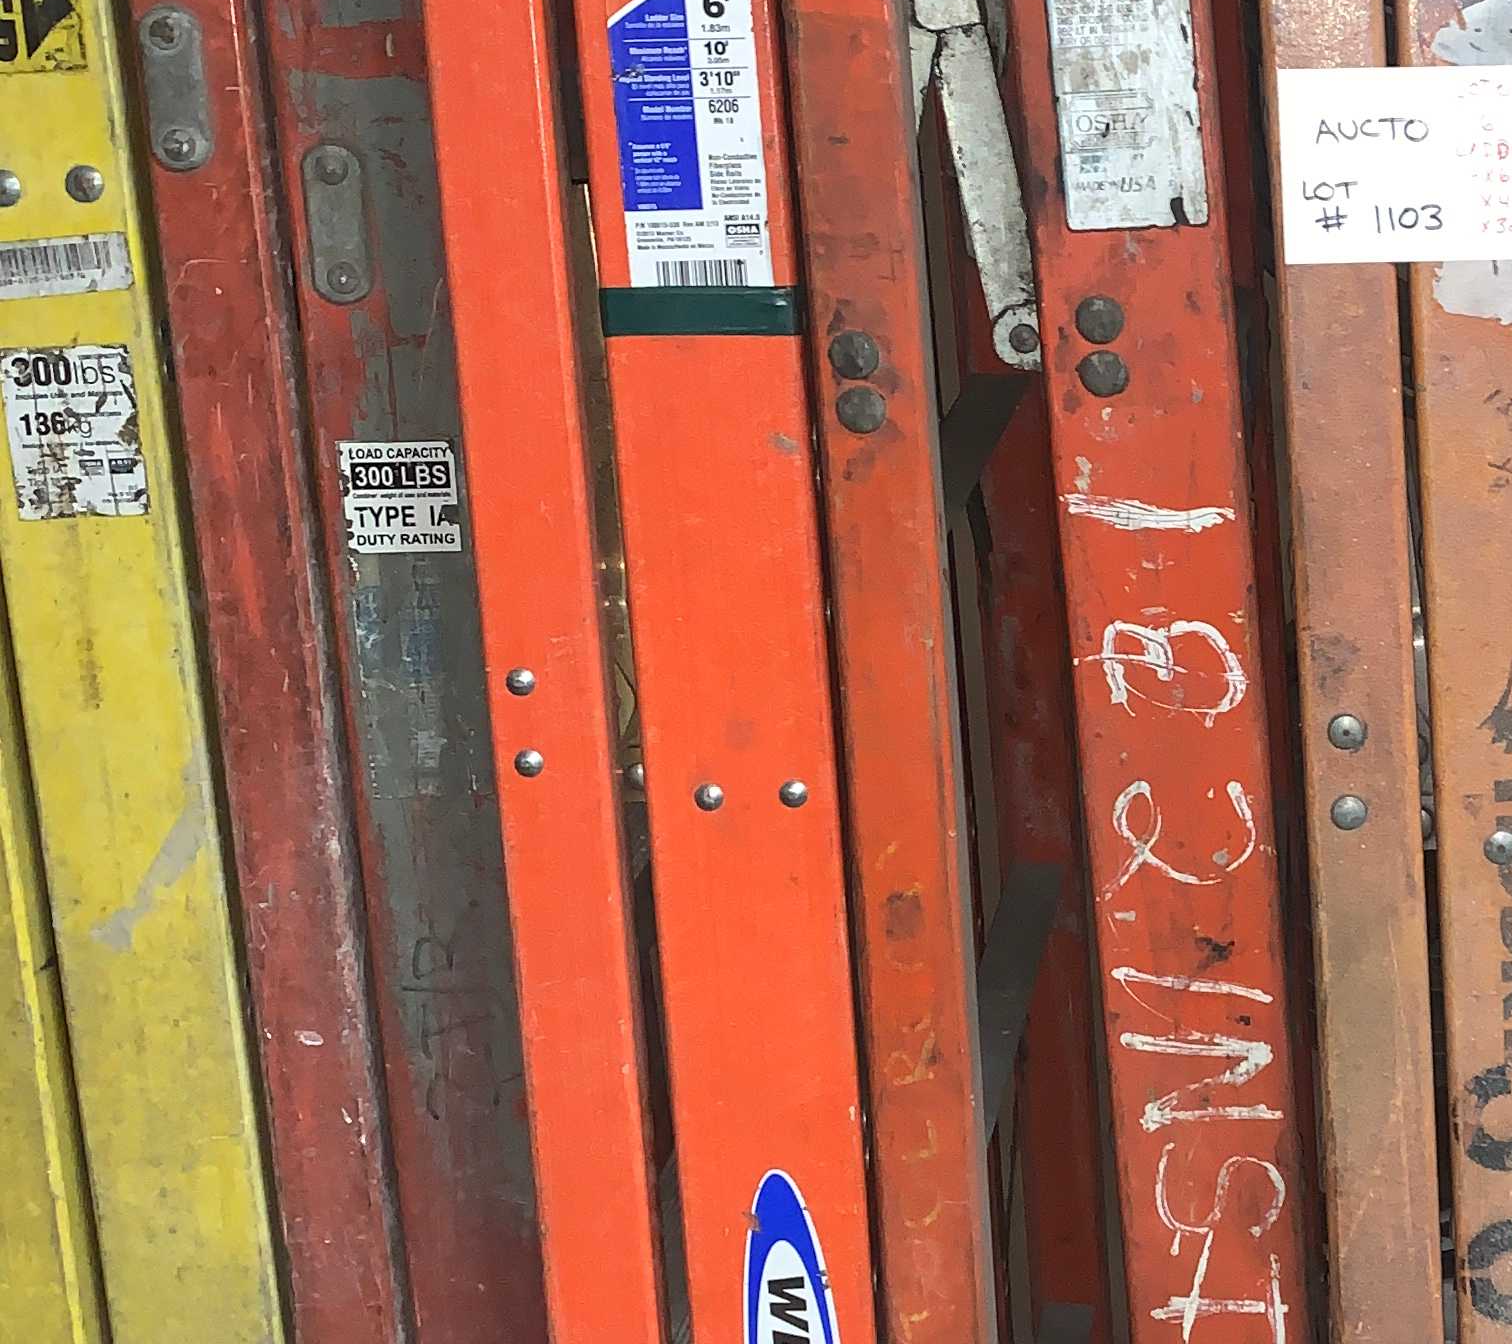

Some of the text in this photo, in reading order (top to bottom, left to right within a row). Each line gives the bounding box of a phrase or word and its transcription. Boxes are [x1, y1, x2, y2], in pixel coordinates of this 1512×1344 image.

[708, 99, 740, 114] 6206
[1316, 117, 1430, 145] AUCTO
[1302, 179, 1359, 202] LOT
[1315, 203, 1444, 234] # 1103
[727, 226, 759, 235] OSHA
[11, 356, 116, 387] 300 lbs
[19, 412, 65, 436] 136
[349, 446, 448, 460] LOAD CAPACITY
[354, 464, 448, 487] 300 LBS
[354, 505, 416, 527] TYPE
[357, 533, 456, 546] DUTY RATING
